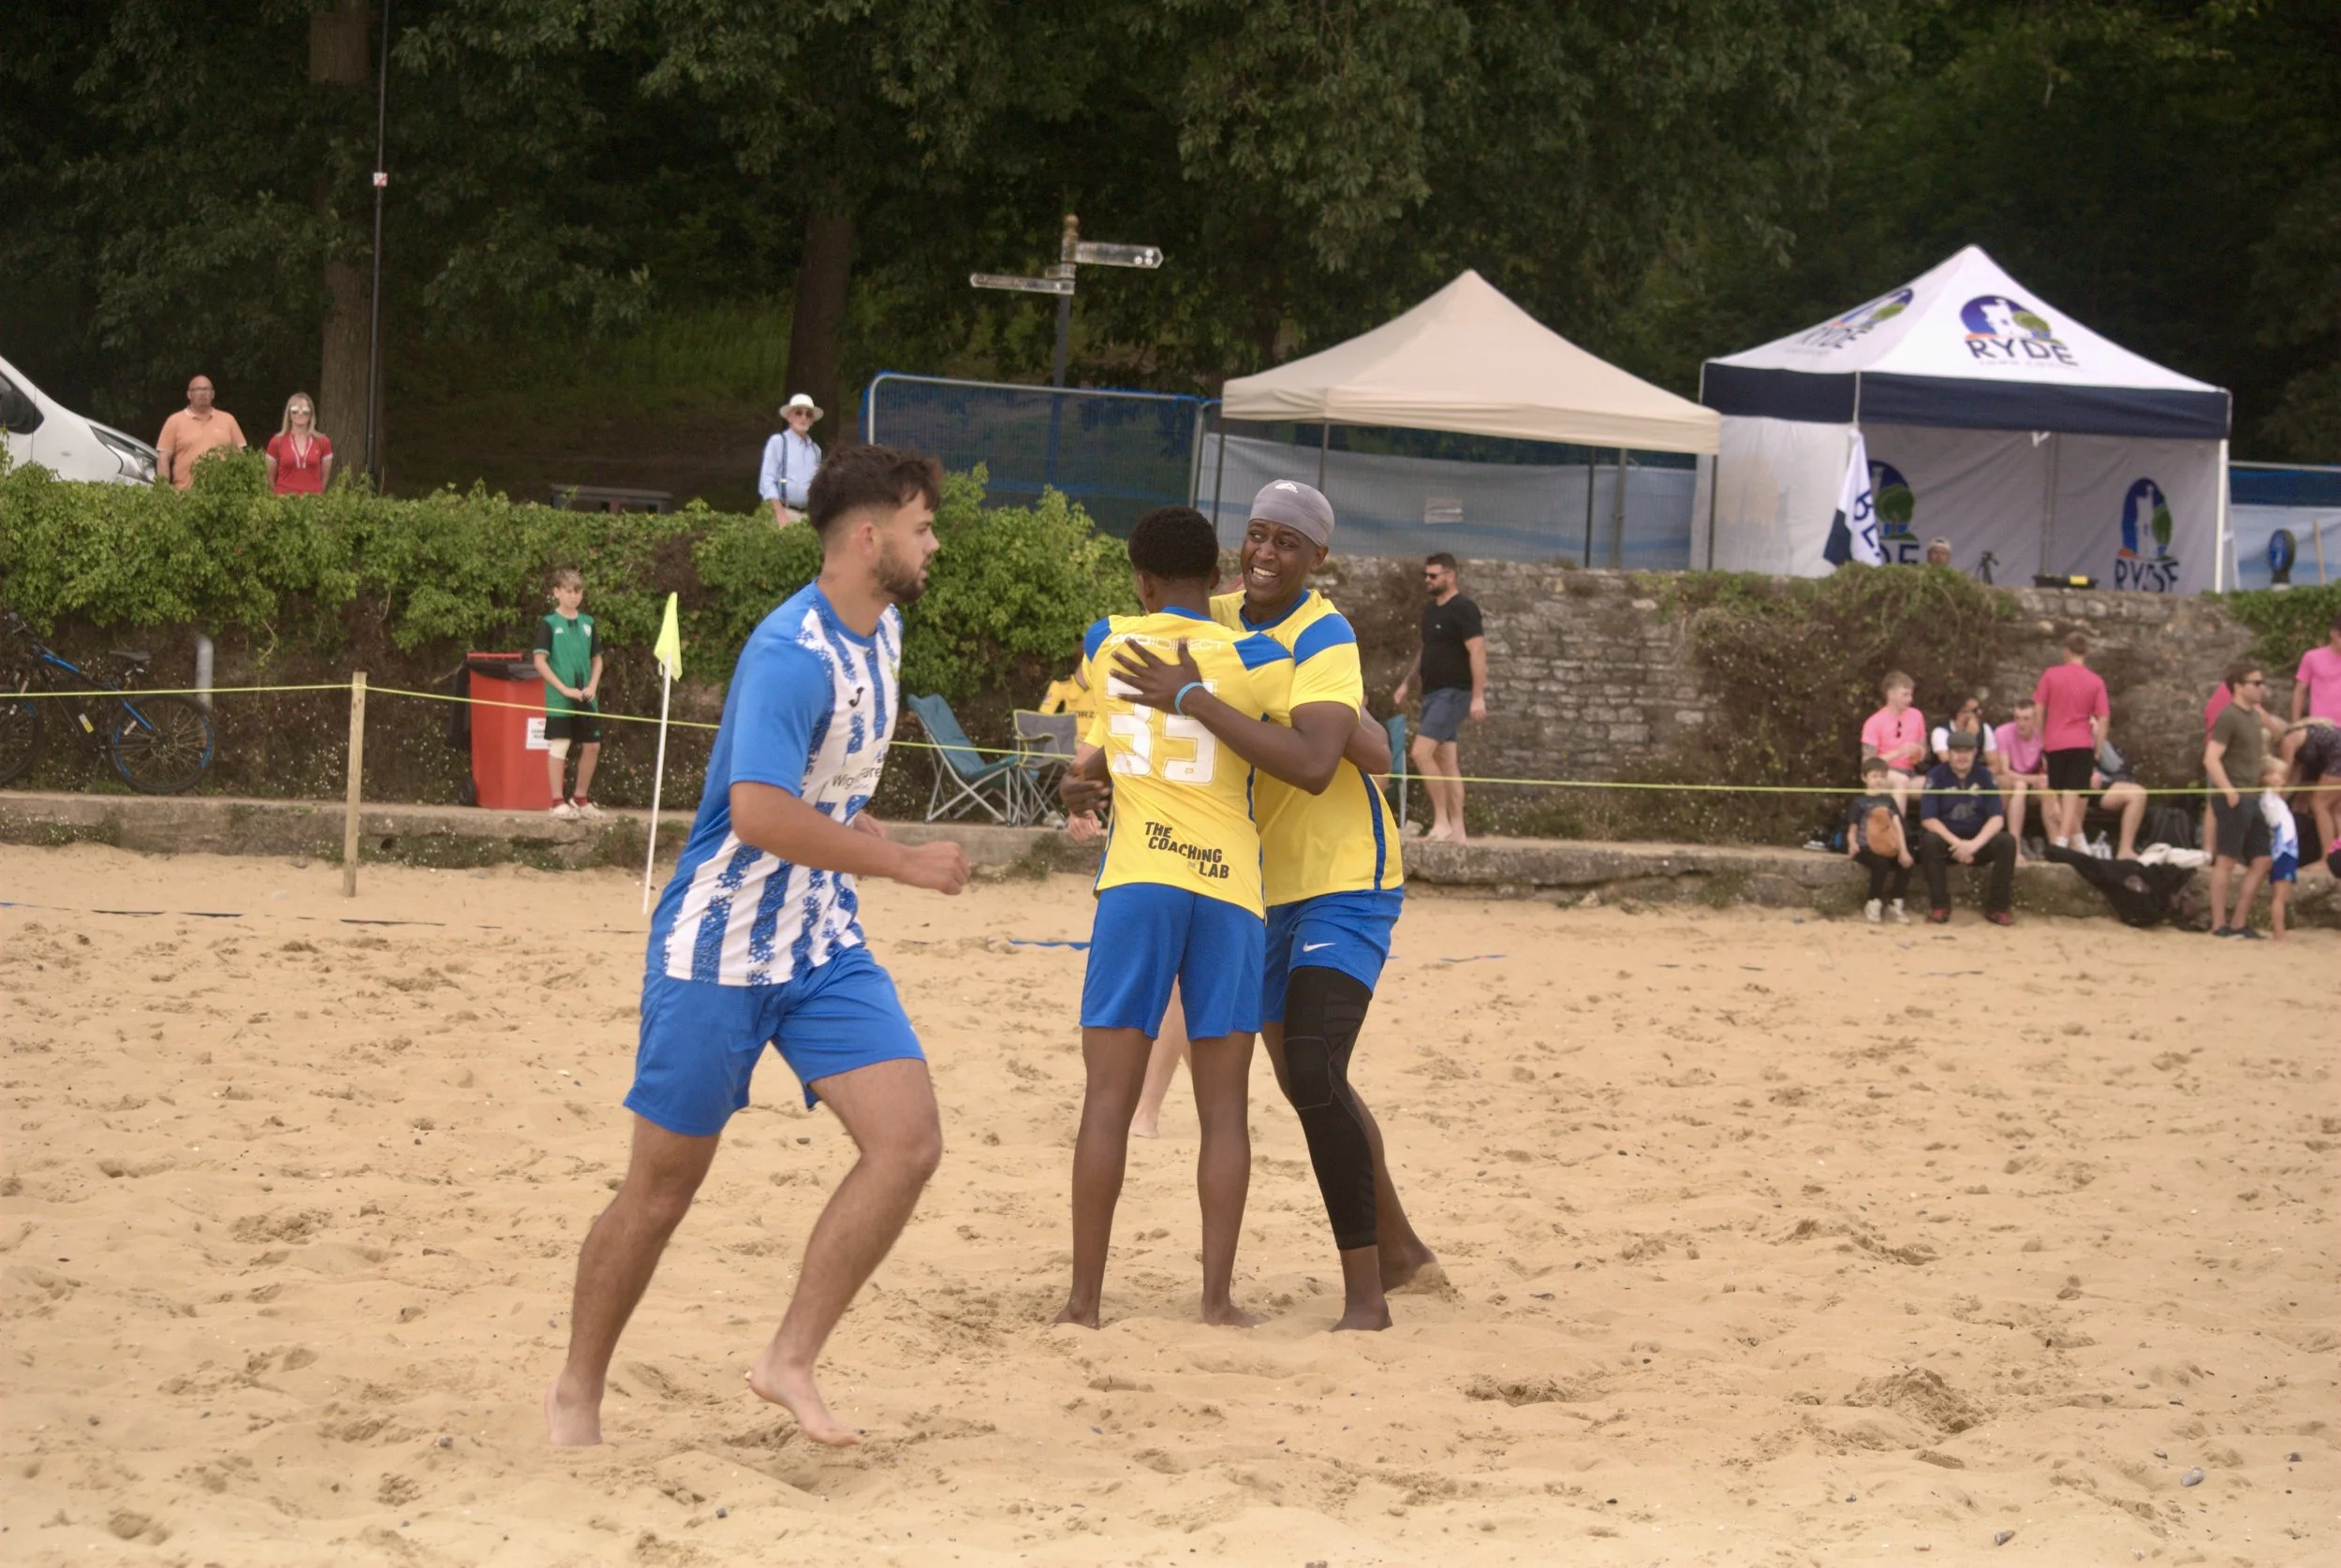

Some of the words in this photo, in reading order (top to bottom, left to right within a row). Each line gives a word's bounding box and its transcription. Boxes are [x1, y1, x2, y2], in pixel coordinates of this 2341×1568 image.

[1965, 338, 2079, 366] RYDE
[1145, 821, 1173, 839] THE
[1148, 836, 1223, 864] COACHING
[1199, 861, 1229, 879] LAB
